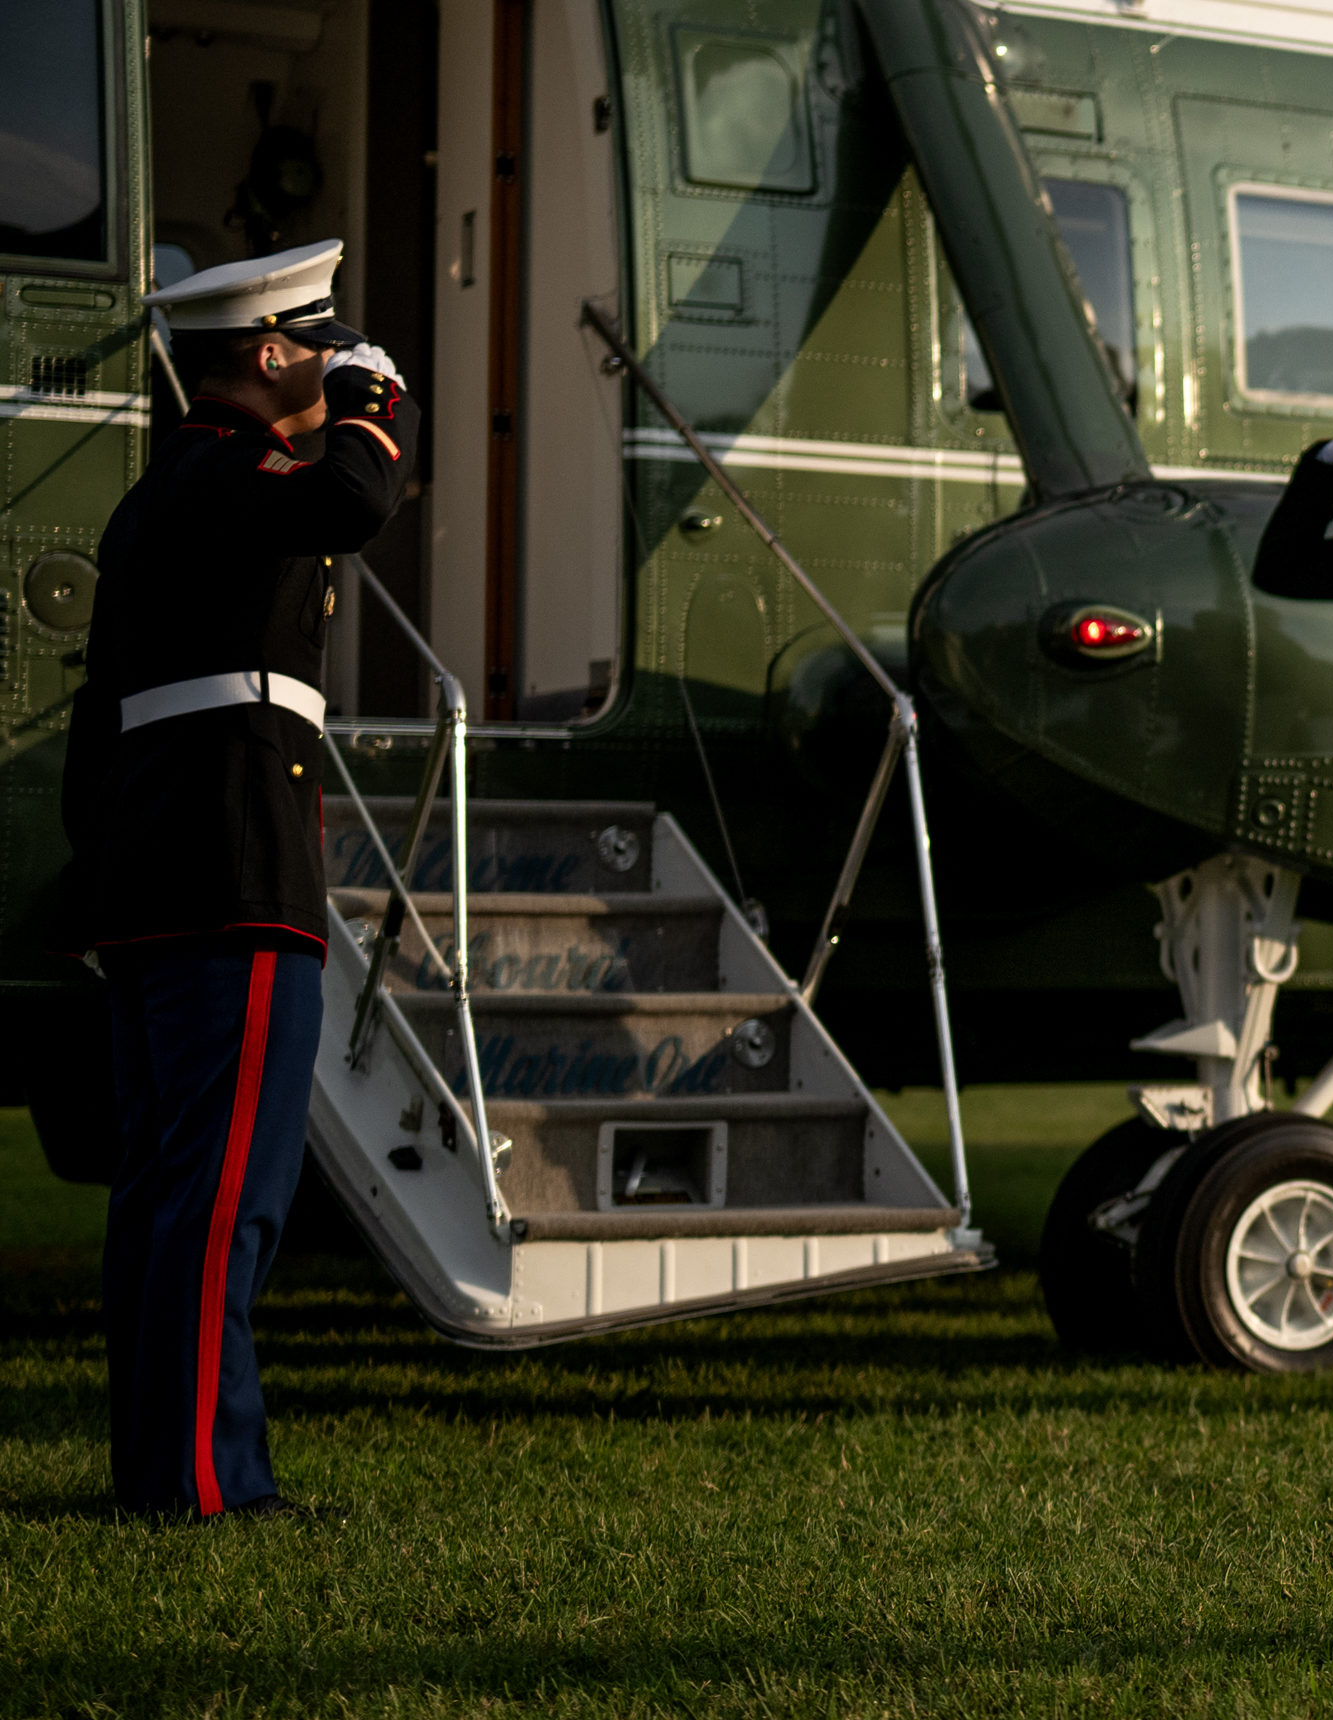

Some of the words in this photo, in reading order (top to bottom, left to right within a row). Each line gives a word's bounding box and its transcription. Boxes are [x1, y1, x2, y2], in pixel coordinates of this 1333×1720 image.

[335, 831, 580, 892] Wlcome
[453, 1034, 640, 1094] Marine
[645, 1035, 727, 1093] One
